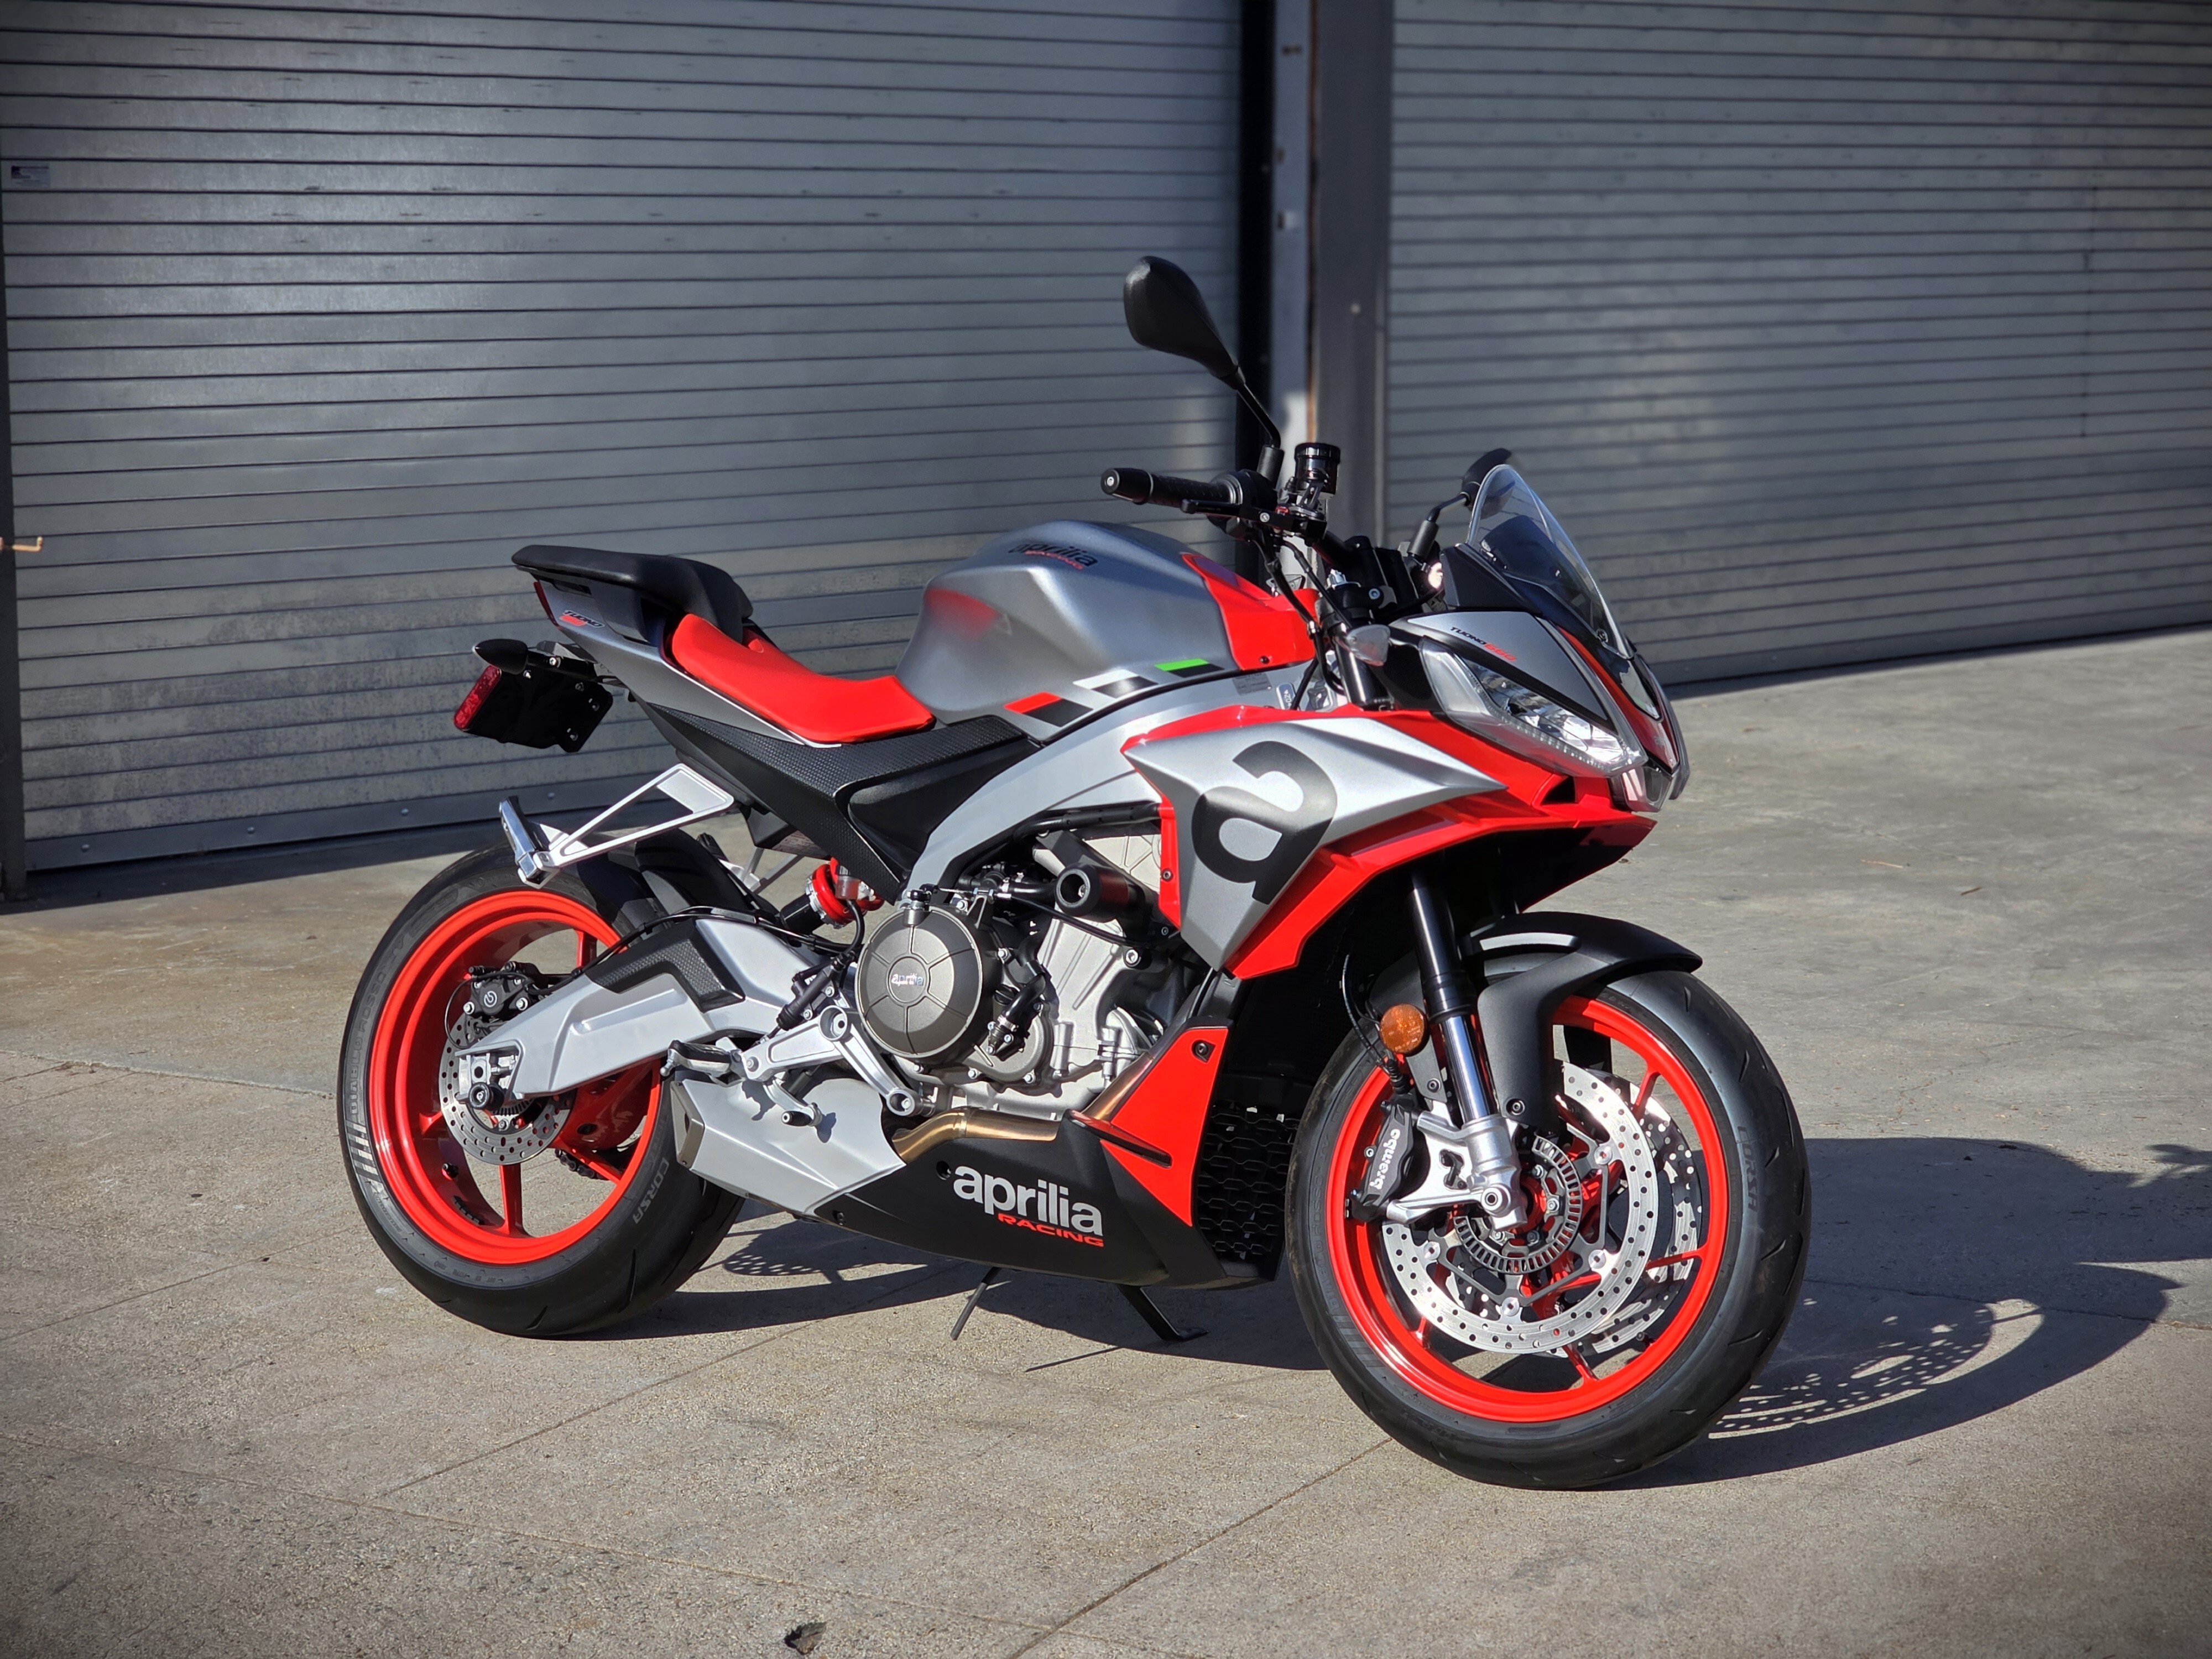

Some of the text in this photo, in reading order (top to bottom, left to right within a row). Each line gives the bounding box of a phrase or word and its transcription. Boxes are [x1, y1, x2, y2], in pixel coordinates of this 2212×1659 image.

[1008, 544, 1098, 567] aprilia
[1450, 627, 1487, 645] TUONO
[891, 973, 923, 986] aprilia
[1369, 1128, 1401, 1190] brembo
[1738, 1126, 1757, 1212] CORSA
[633, 1157, 669, 1224] CORSA
[953, 1166, 1104, 1237] aprilia
[998, 1213, 1104, 1248] RACING
